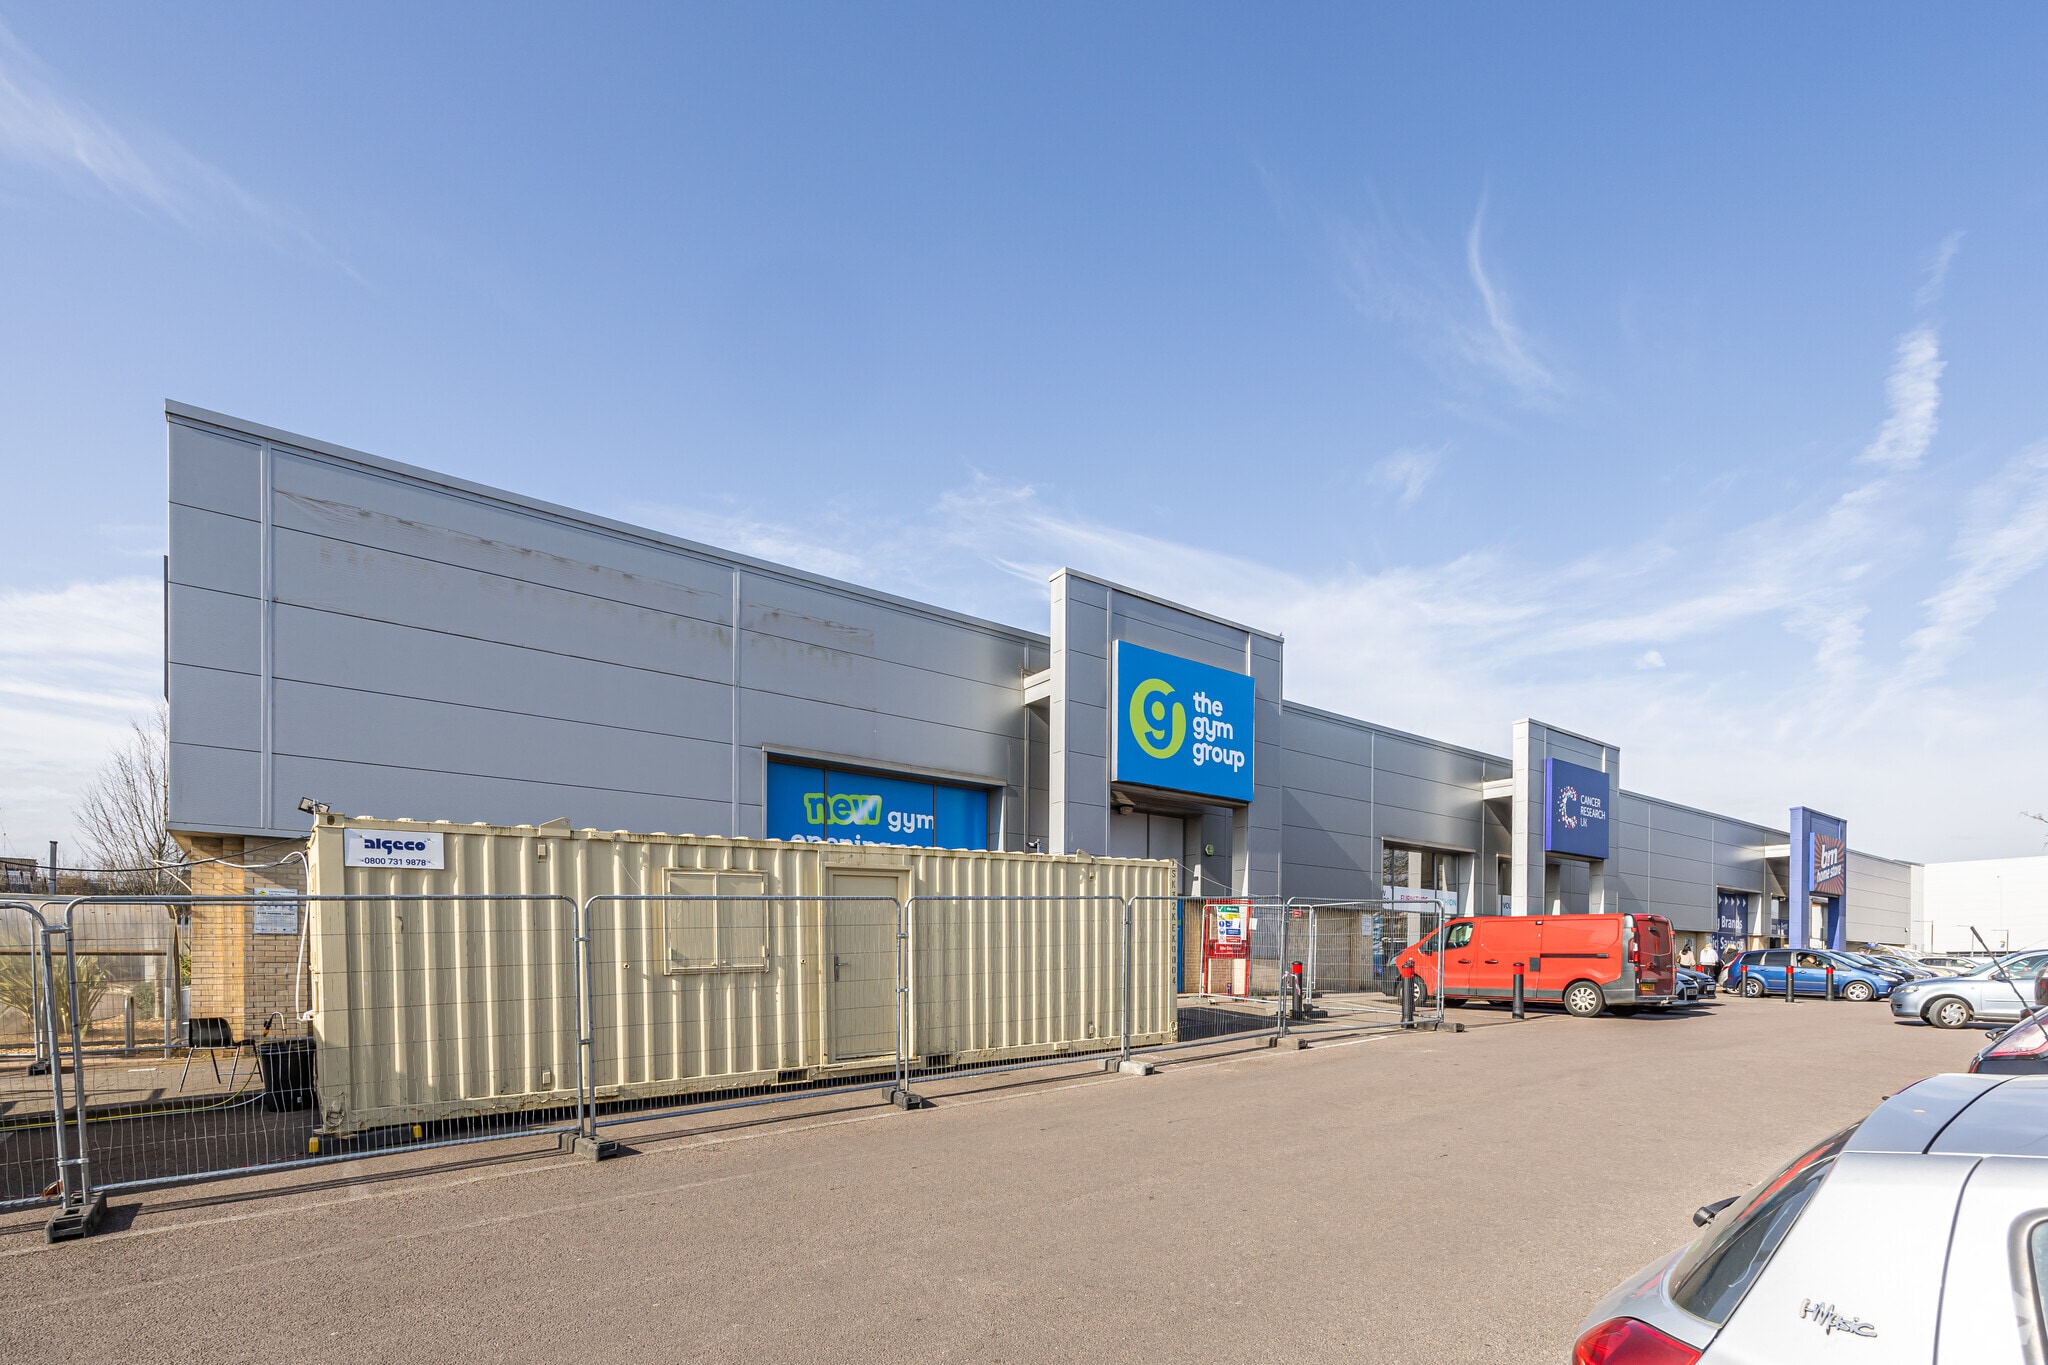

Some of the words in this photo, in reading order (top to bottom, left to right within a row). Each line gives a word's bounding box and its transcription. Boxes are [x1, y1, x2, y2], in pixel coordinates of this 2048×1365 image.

[1193, 692, 1223, 717] the
[1193, 716, 1233, 742] gym
[1193, 743, 1245, 773] group
[1580, 795, 1601, 807] CANCER
[805, 794, 881, 824] new
[887, 811, 934, 833] gym
[1580, 806, 1606, 820] RESEARCH
[1580, 818, 1588, 827] UK
[364, 838, 426, 855] algeco
[364, 857, 386, 865] 0800
[405, 858, 427, 866] 9878
[1721, 915, 1743, 930] Brands
